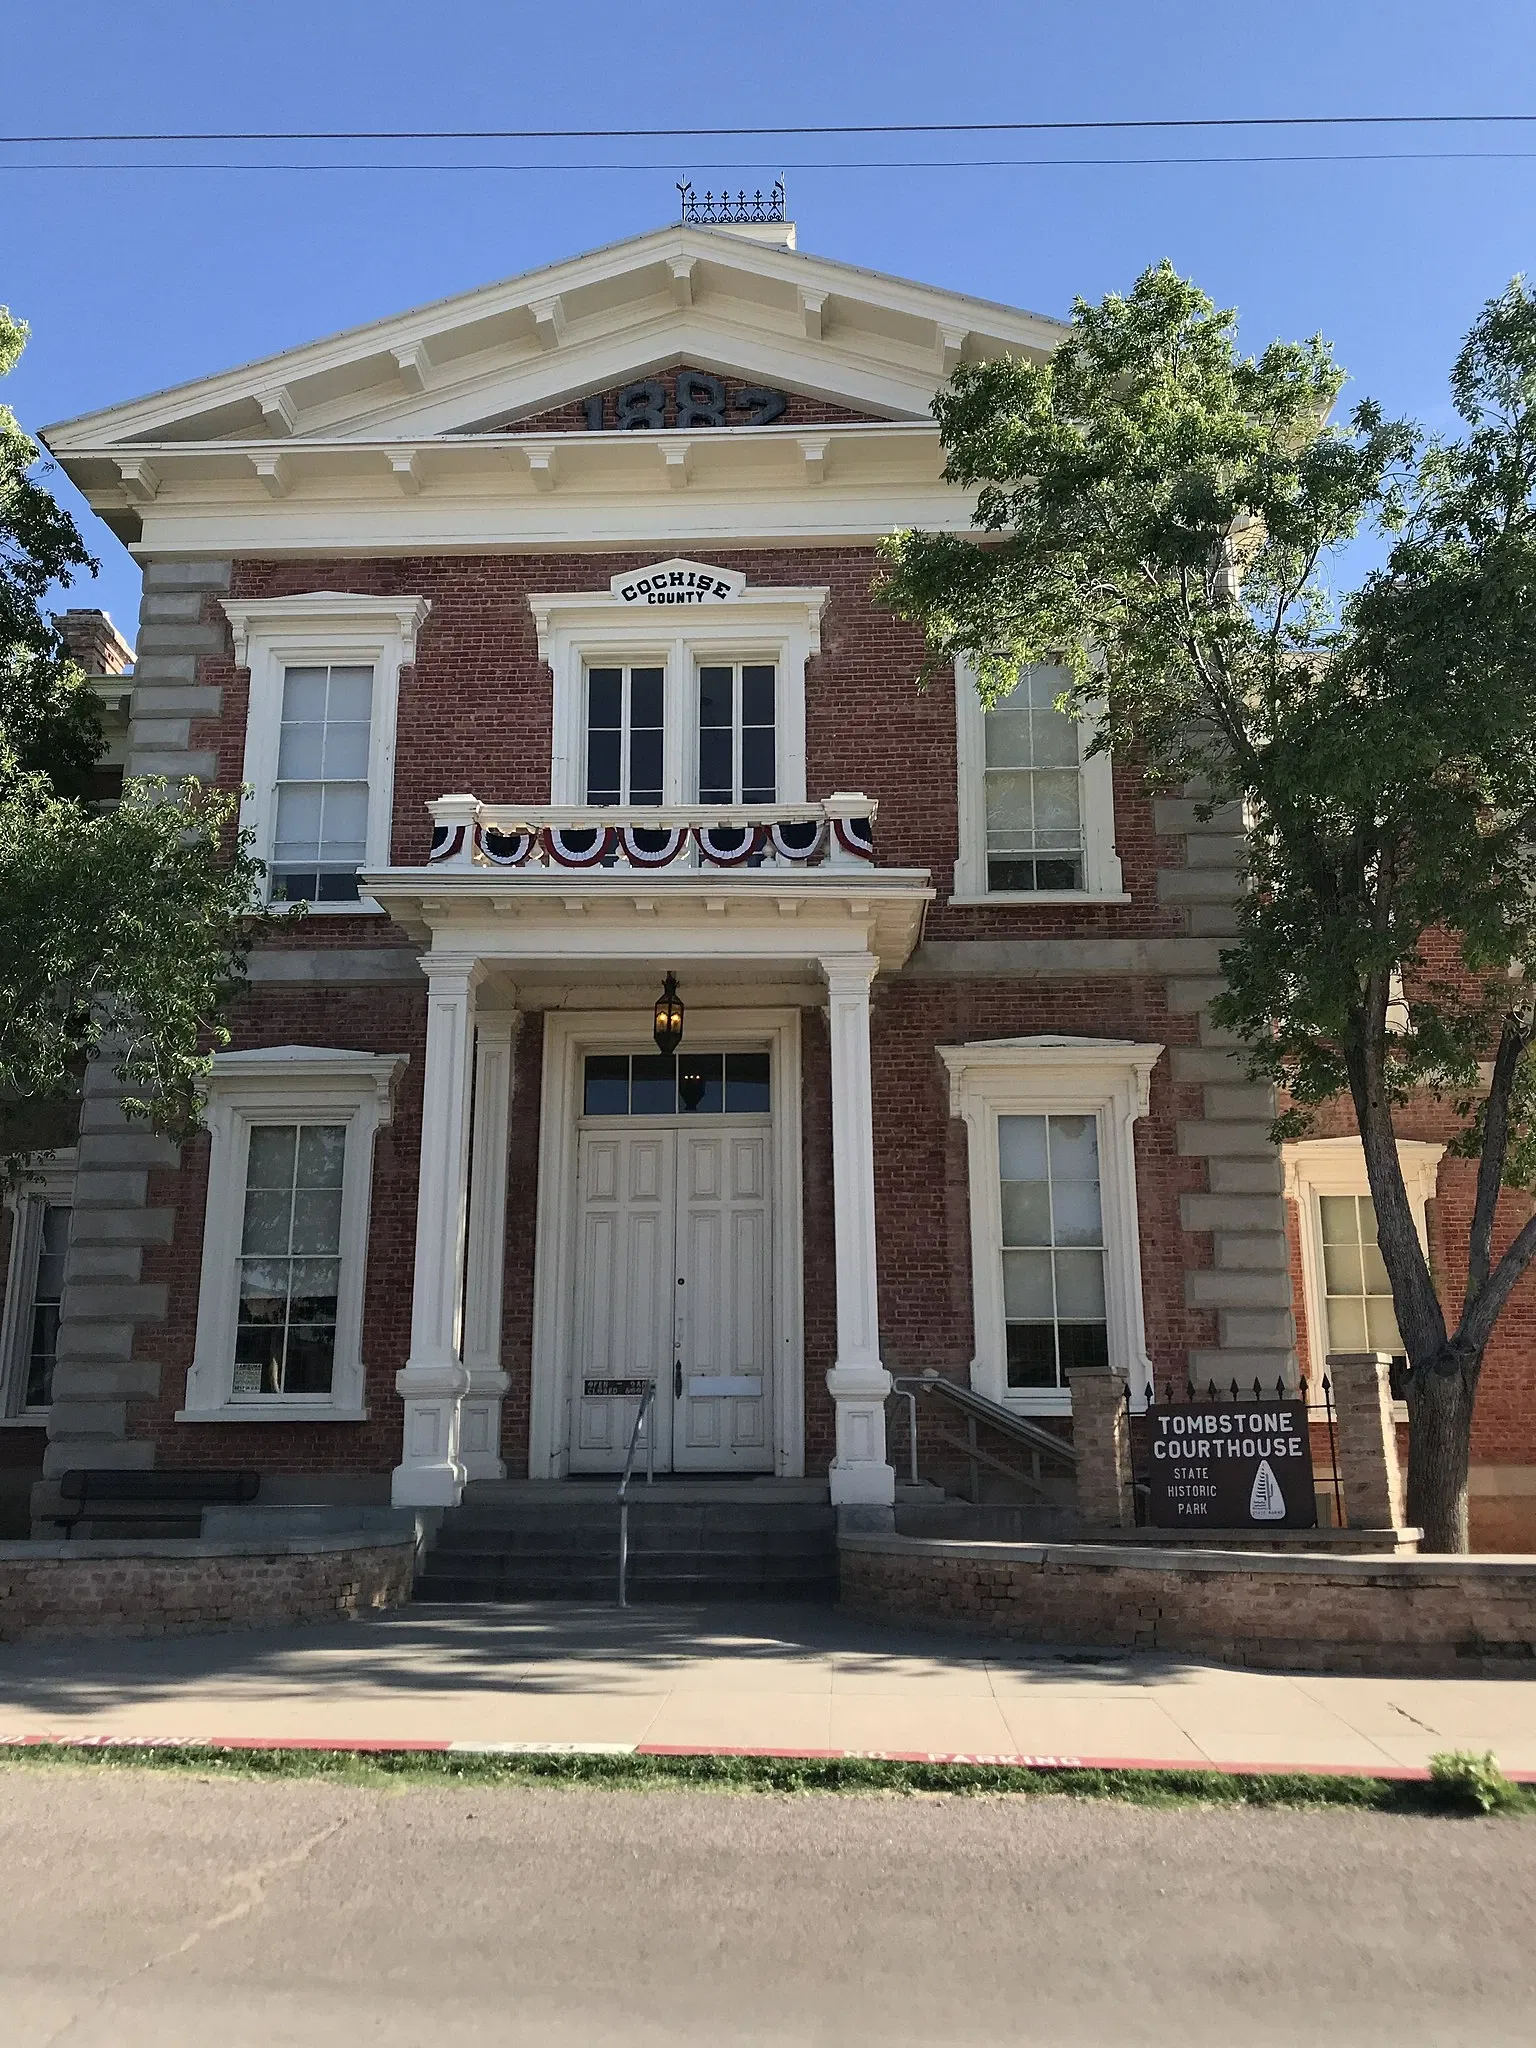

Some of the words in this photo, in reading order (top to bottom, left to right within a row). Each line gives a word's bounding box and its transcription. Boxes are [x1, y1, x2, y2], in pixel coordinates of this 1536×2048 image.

[621, 572, 731, 601] COCHISE
[647, 591, 704, 604] COUNTY
[1158, 1413, 1293, 1434] TOMBSTONE
[1154, 1438, 1302, 1458] COURTHOUSE
[1174, 1467, 1209, 1479] STATE
[1167, 1485, 1217, 1497] HISTORIC
[1178, 1503, 1208, 1514] PARK
[927, 1753, 1082, 1766] PARKING
